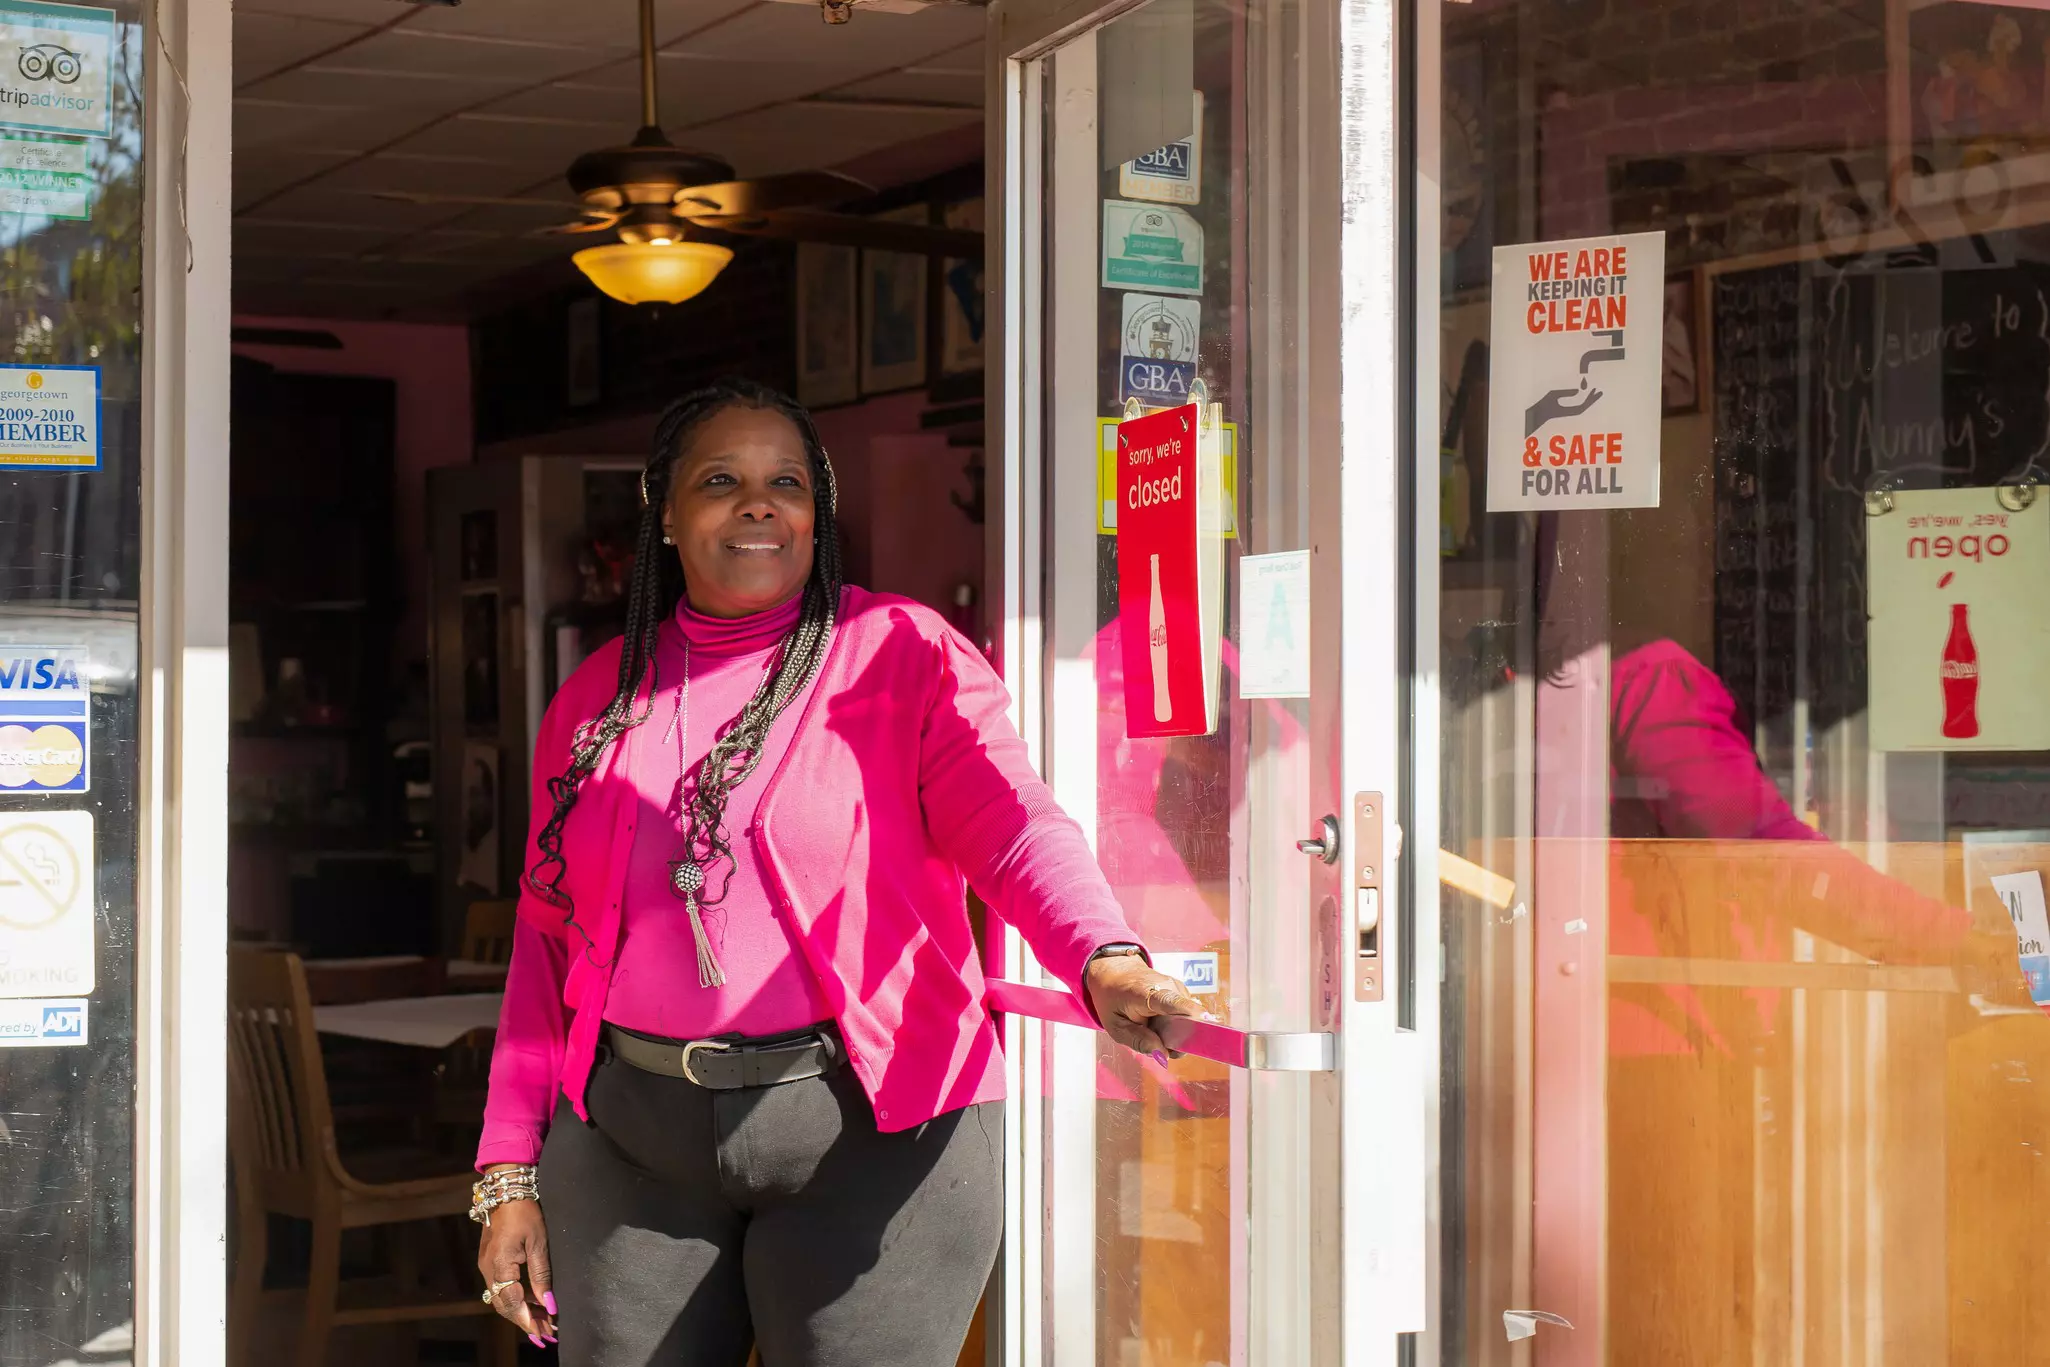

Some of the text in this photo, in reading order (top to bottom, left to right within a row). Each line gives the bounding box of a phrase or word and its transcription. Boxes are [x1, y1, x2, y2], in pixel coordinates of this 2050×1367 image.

[0, 87, 94, 111] tripadvisor
[20, 145, 63, 157] Certifice
[30, 174, 84, 189] WINNER
[1126, 179, 1196, 201] MEMBER
[1528, 246, 1627, 282] WE ARE
[1527, 275, 1628, 302] KEEPING IT
[1526, 295, 1627, 335] CLEAN
[1837, 276, 1977, 390] Welcome
[1991, 294, 2021, 338] to
[1128, 362, 1189, 394] GBA
[0, 390, 69, 402] georgetown
[0, 408, 75, 423] 2009-2010
[0, 424, 88, 442] EMBER
[1129, 438, 1182, 466] sorry, we're
[1522, 432, 1623, 467] & SAFE
[1128, 465, 1182, 510] closed
[1521, 466, 1623, 496] FOR ALL
[0, 658, 80, 690] VISA
[1183, 963, 1214, 983] ADT
[23, 1020, 38, 1035] by
[43, 1010, 81, 1033] ADT
